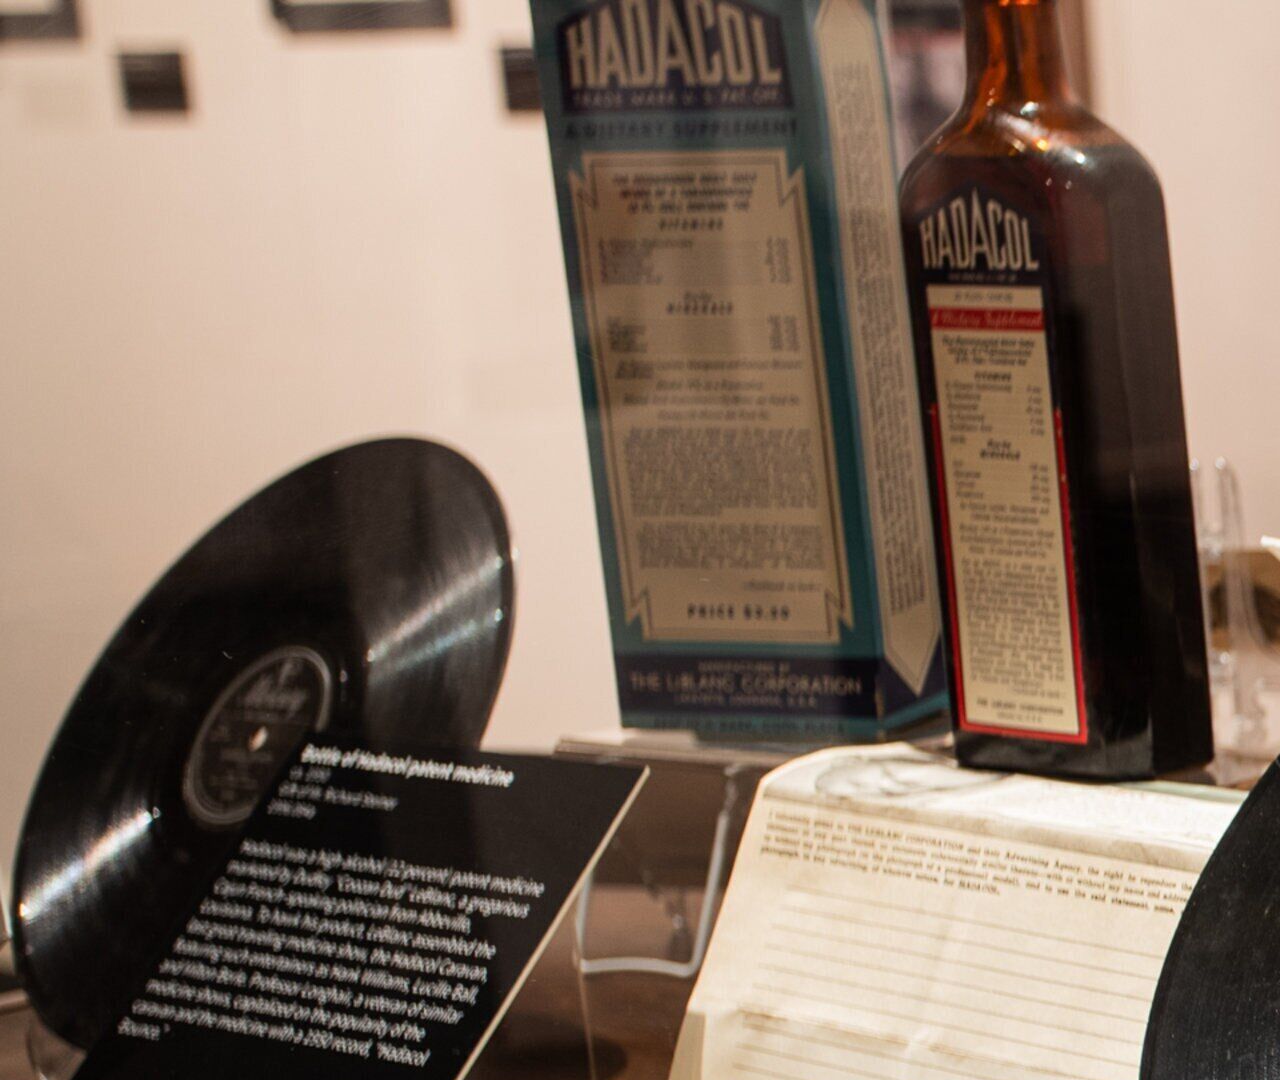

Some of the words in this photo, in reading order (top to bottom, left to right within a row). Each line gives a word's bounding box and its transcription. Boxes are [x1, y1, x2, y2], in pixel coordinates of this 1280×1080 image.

[566, 0, 782, 88] HADACOL
[920, 188, 1039, 271] HADACOL
[687, 604, 735, 619] PRICE
